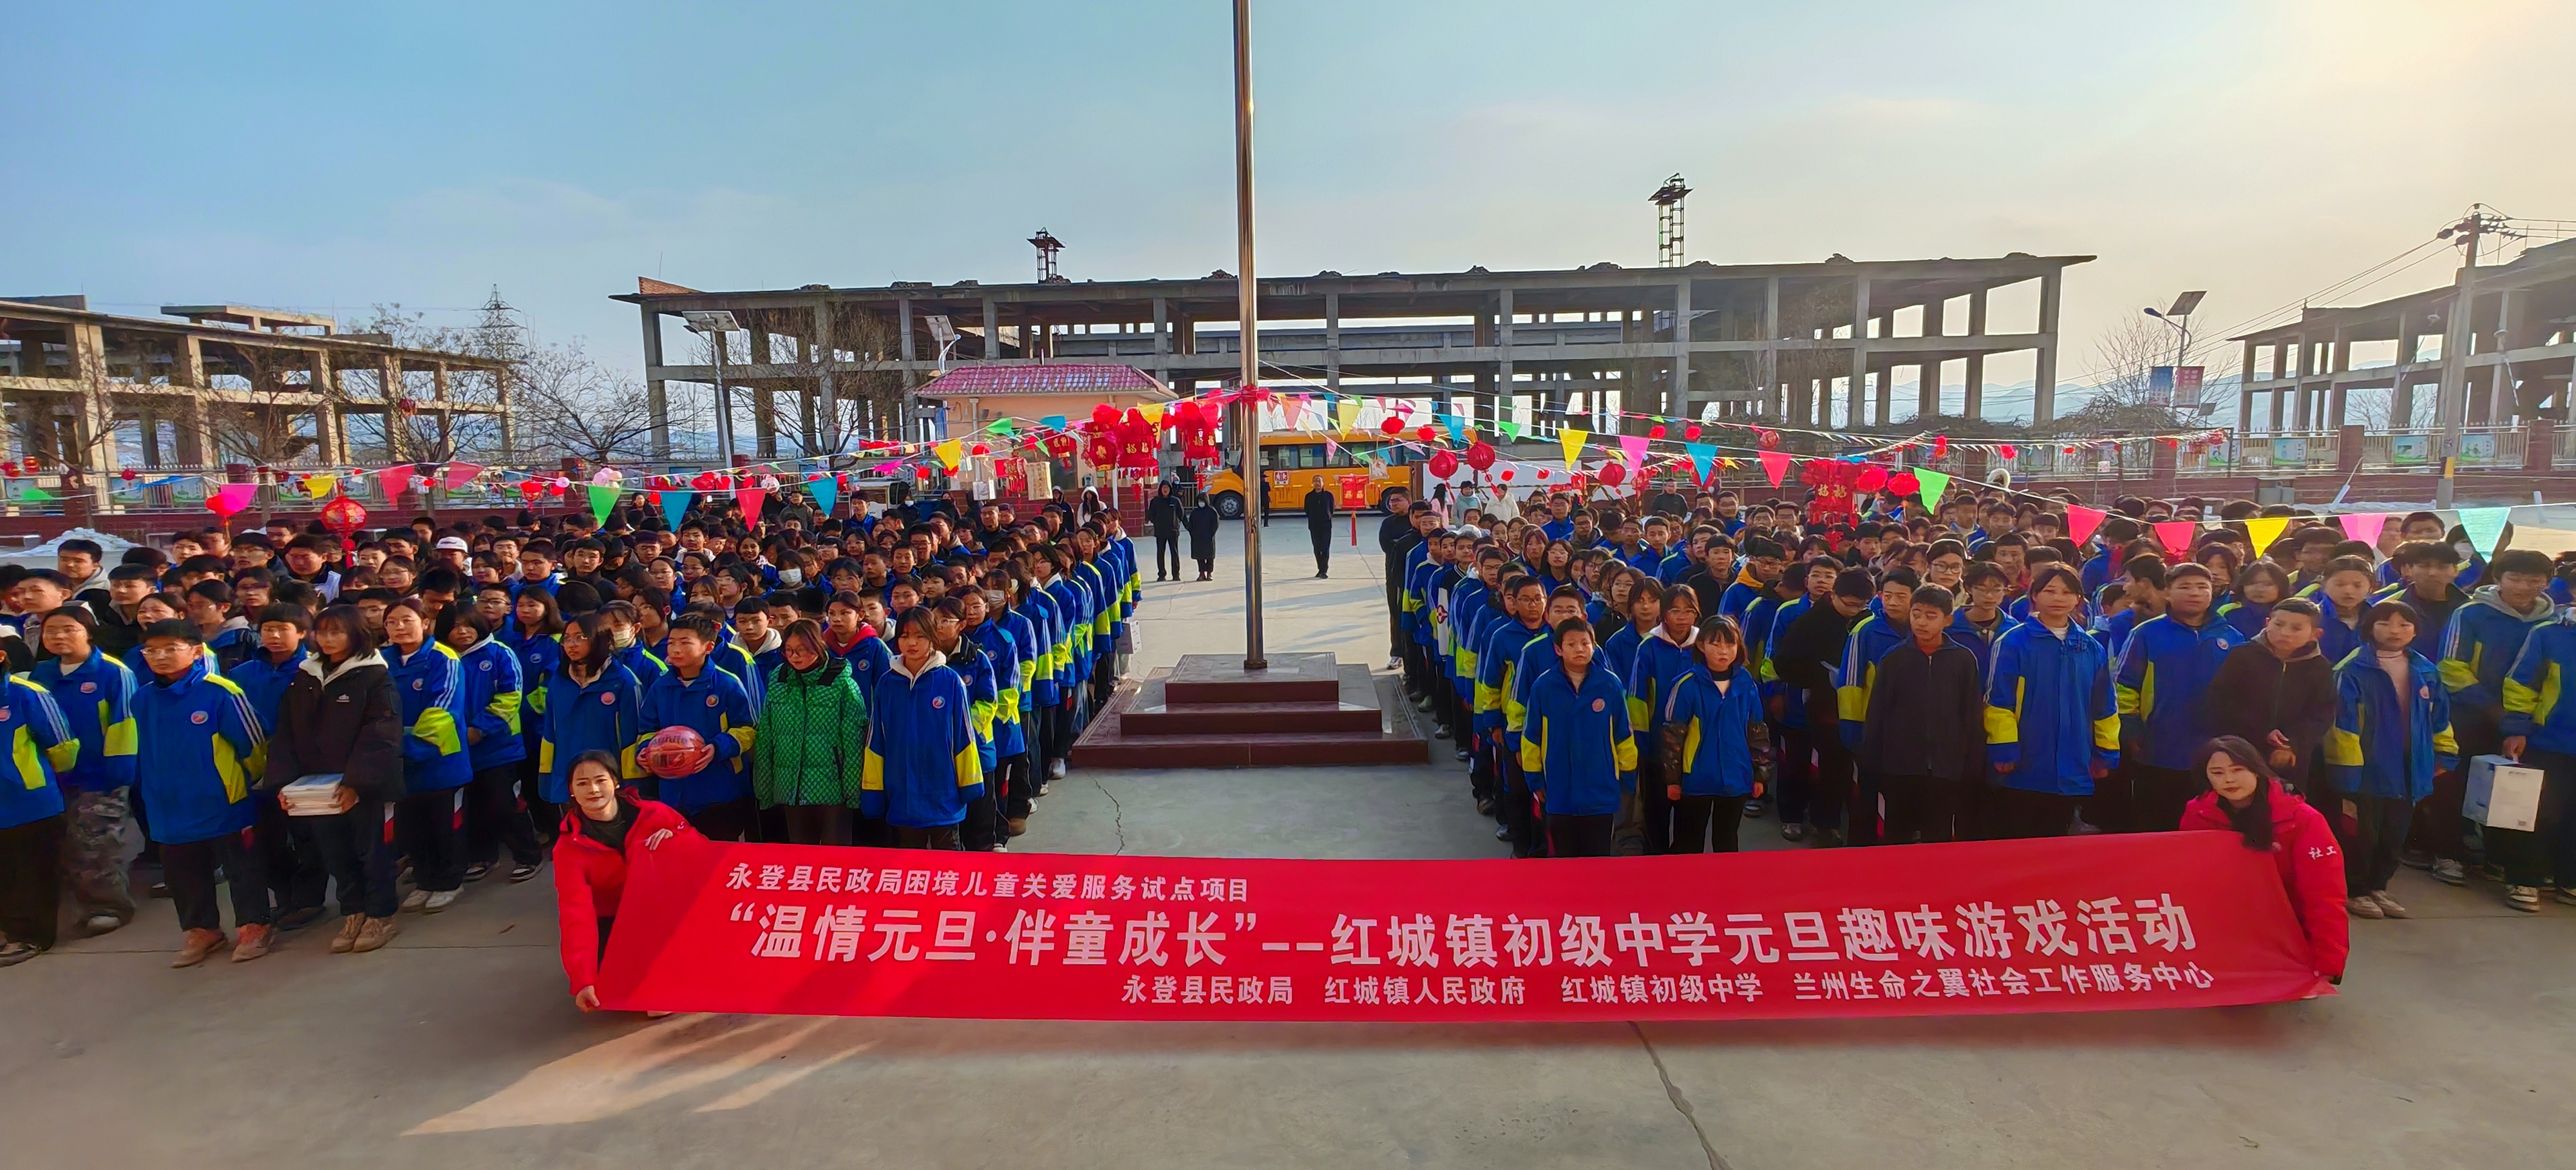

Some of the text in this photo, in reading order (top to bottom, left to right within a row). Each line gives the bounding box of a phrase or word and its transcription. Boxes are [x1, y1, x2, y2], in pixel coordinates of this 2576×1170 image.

[2308, 846, 2337, 860] 社工
[726, 863, 1247, 901] 永登县民政局困境儿童关爱服务试点项目
[1122, 962, 2214, 1004] 永登县民政局 红城镇人民政府 红城镇初级中学 兰州生命之翼社会工作服务中心
